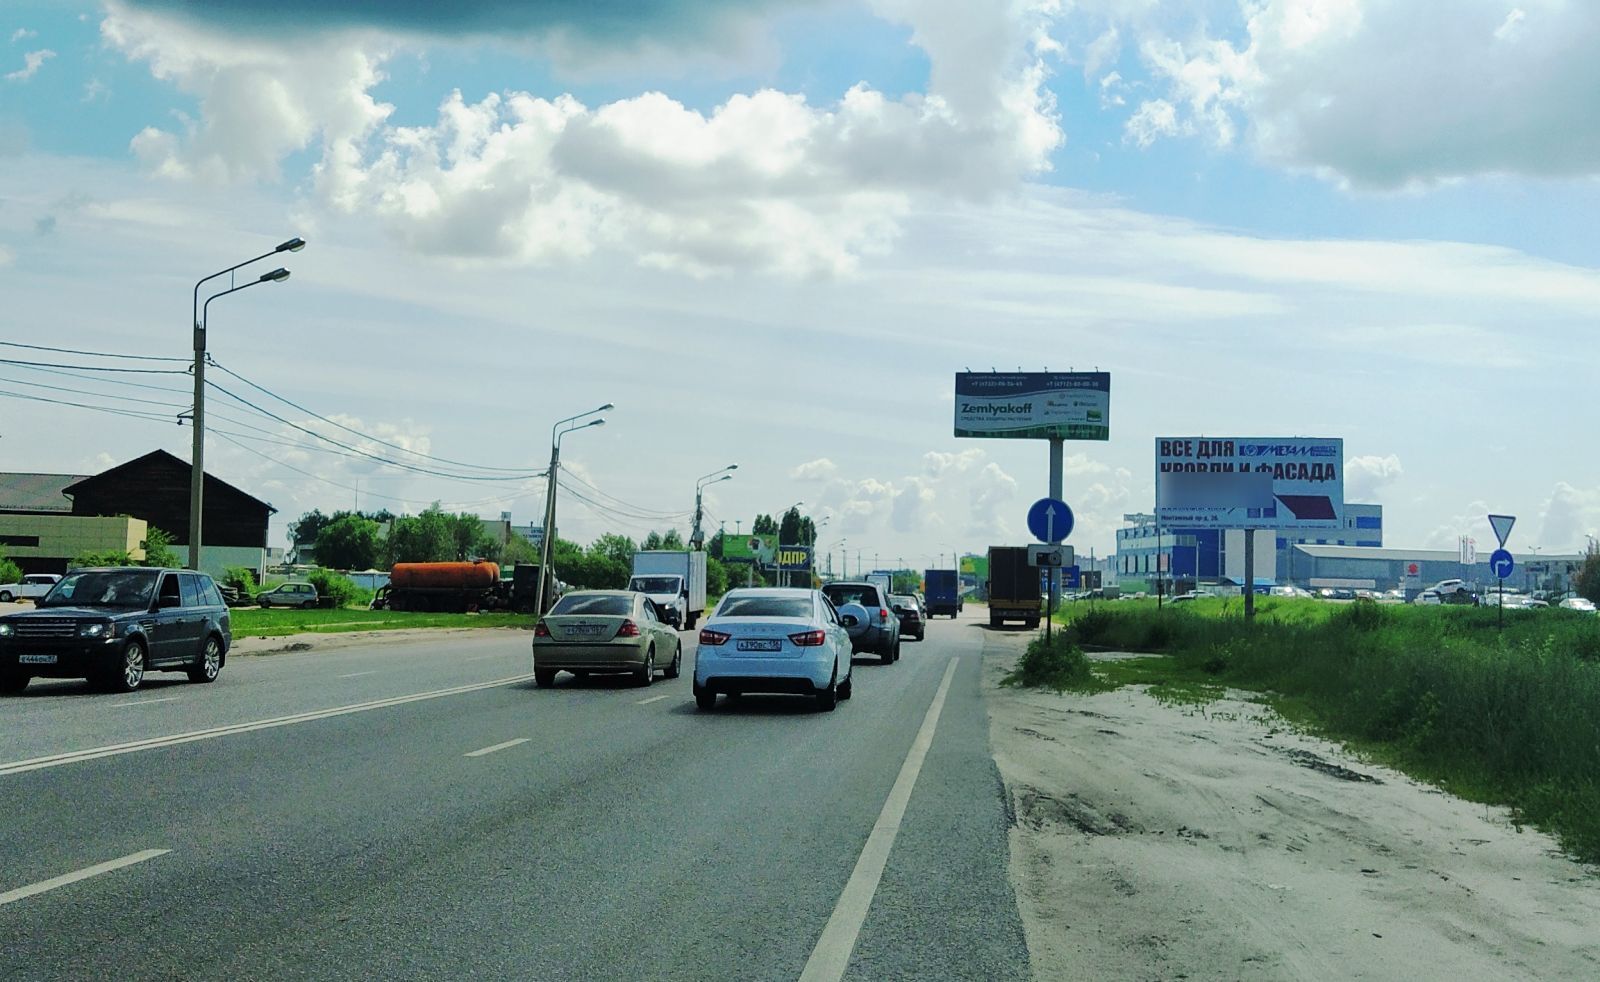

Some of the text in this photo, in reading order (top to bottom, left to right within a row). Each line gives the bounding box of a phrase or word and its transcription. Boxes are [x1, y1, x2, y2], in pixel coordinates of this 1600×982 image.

[961, 403, 1032, 416] Zemlyakoff
[1161, 441, 1234, 459] ВСЕ ДЛЯ
